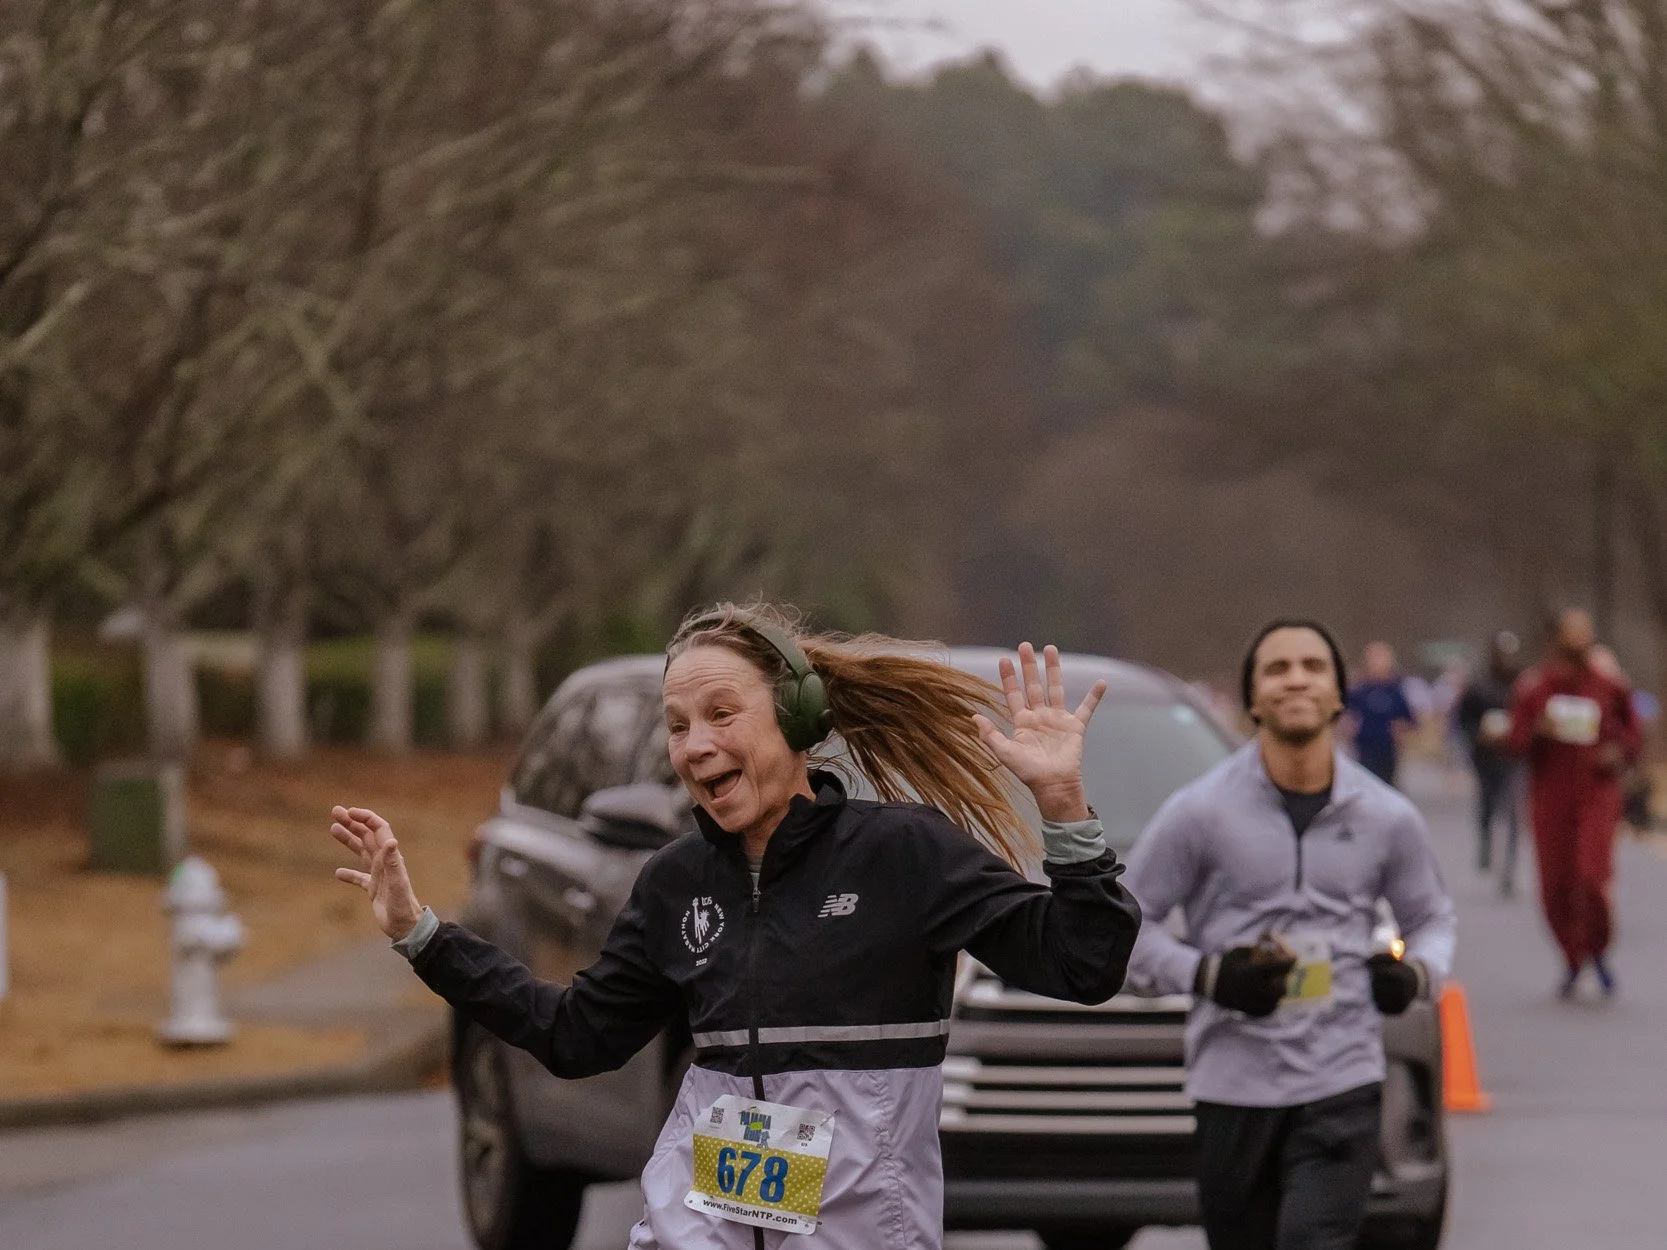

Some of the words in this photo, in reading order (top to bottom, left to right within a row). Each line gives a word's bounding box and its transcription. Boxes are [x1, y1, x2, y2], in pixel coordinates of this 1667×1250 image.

[714, 903, 725, 920] NEW
[681, 910, 696, 953] MARATHON
[709, 921, 725, 942] YORK
[696, 942, 709, 954] CITY
[717, 1146, 789, 1203] 678
[703, 1199, 798, 1225] www.FiveStarNTP.com
